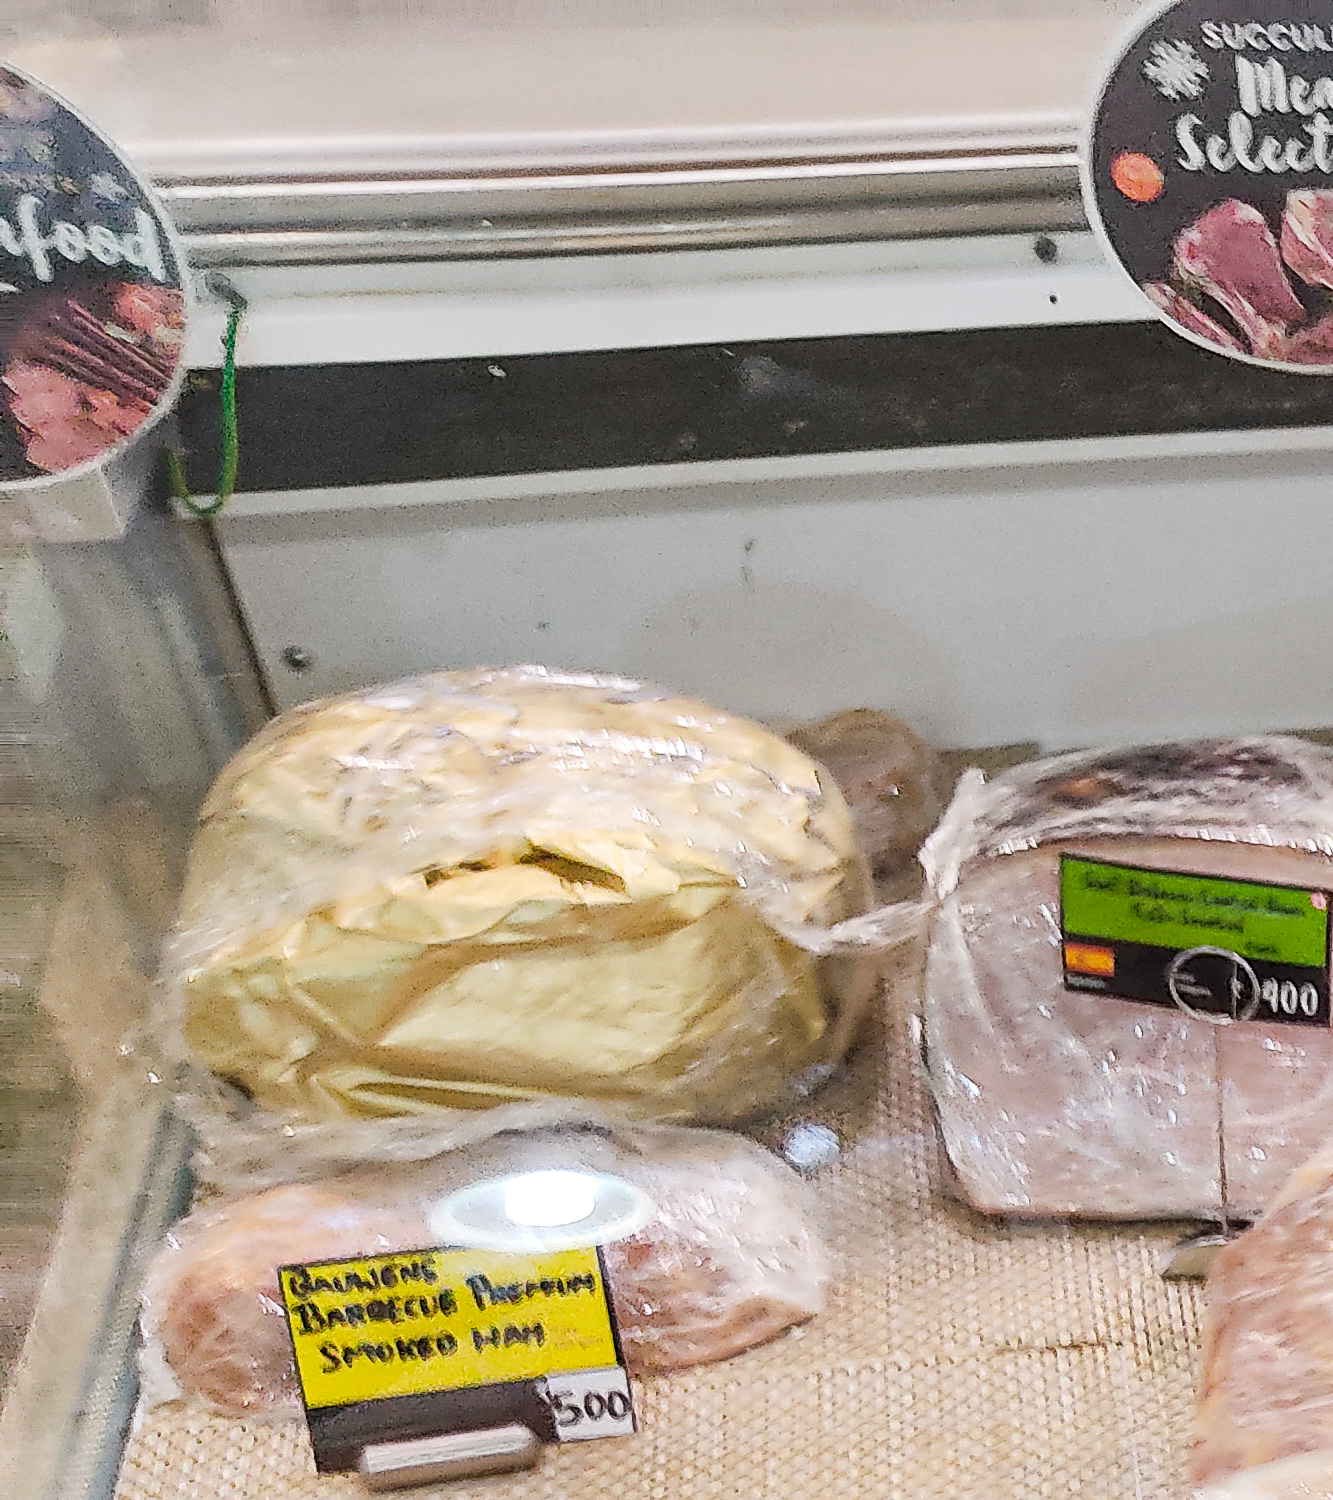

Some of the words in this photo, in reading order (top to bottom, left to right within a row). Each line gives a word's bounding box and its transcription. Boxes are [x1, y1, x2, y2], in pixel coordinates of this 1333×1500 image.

[291, 1286, 459, 1336] BARBECUE
[319, 1328, 458, 1375] SMOKED
[470, 1320, 547, 1354] HAM
[555, 1389, 632, 1429] 500
